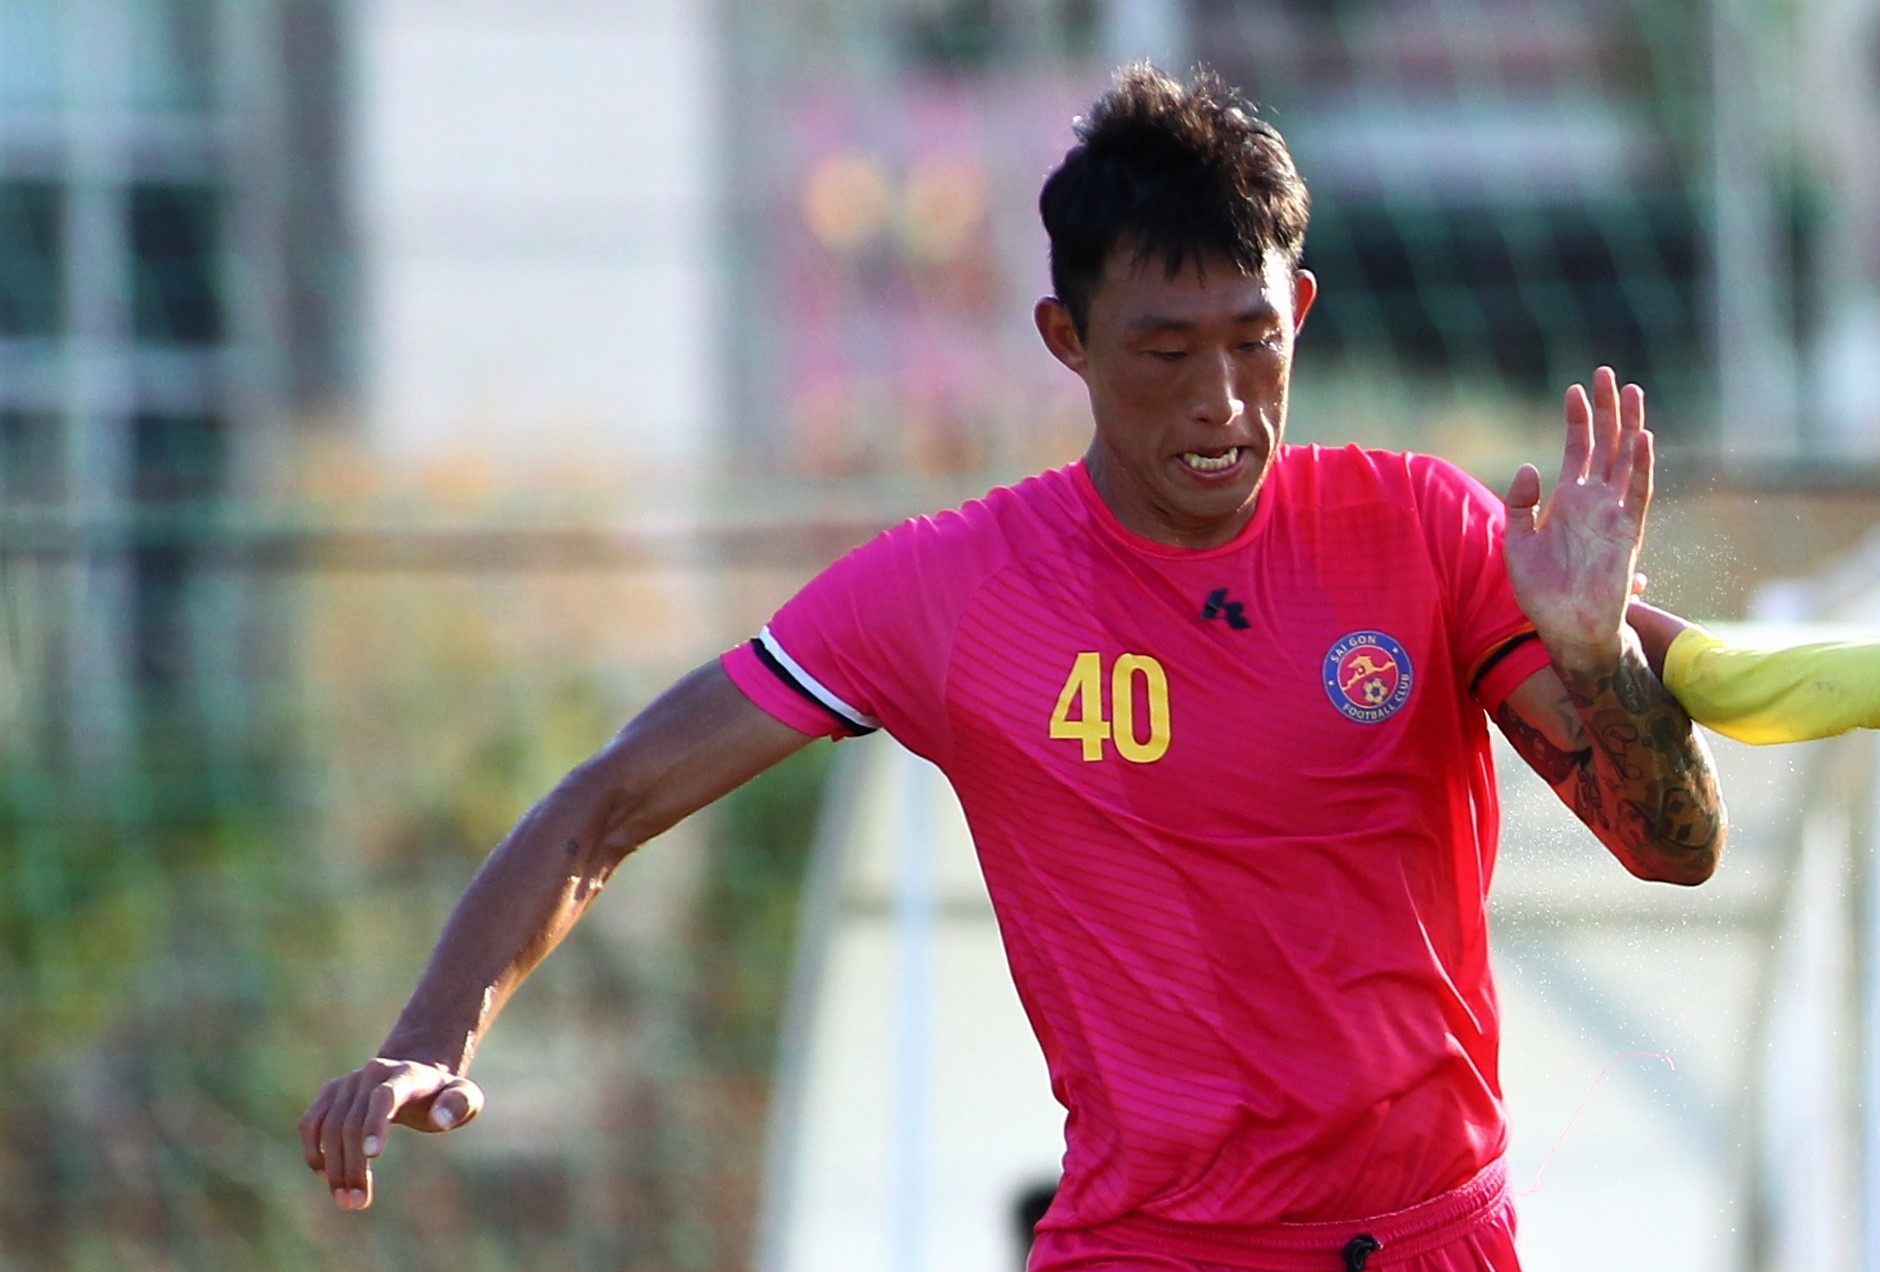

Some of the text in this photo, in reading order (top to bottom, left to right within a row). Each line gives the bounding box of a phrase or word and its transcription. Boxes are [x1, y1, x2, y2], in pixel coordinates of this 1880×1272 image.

[1330, 635, 1377, 663] SAI GON
[1049, 652, 1171, 764] 40
[1342, 673, 1410, 720] FOOTBALL CLUB
